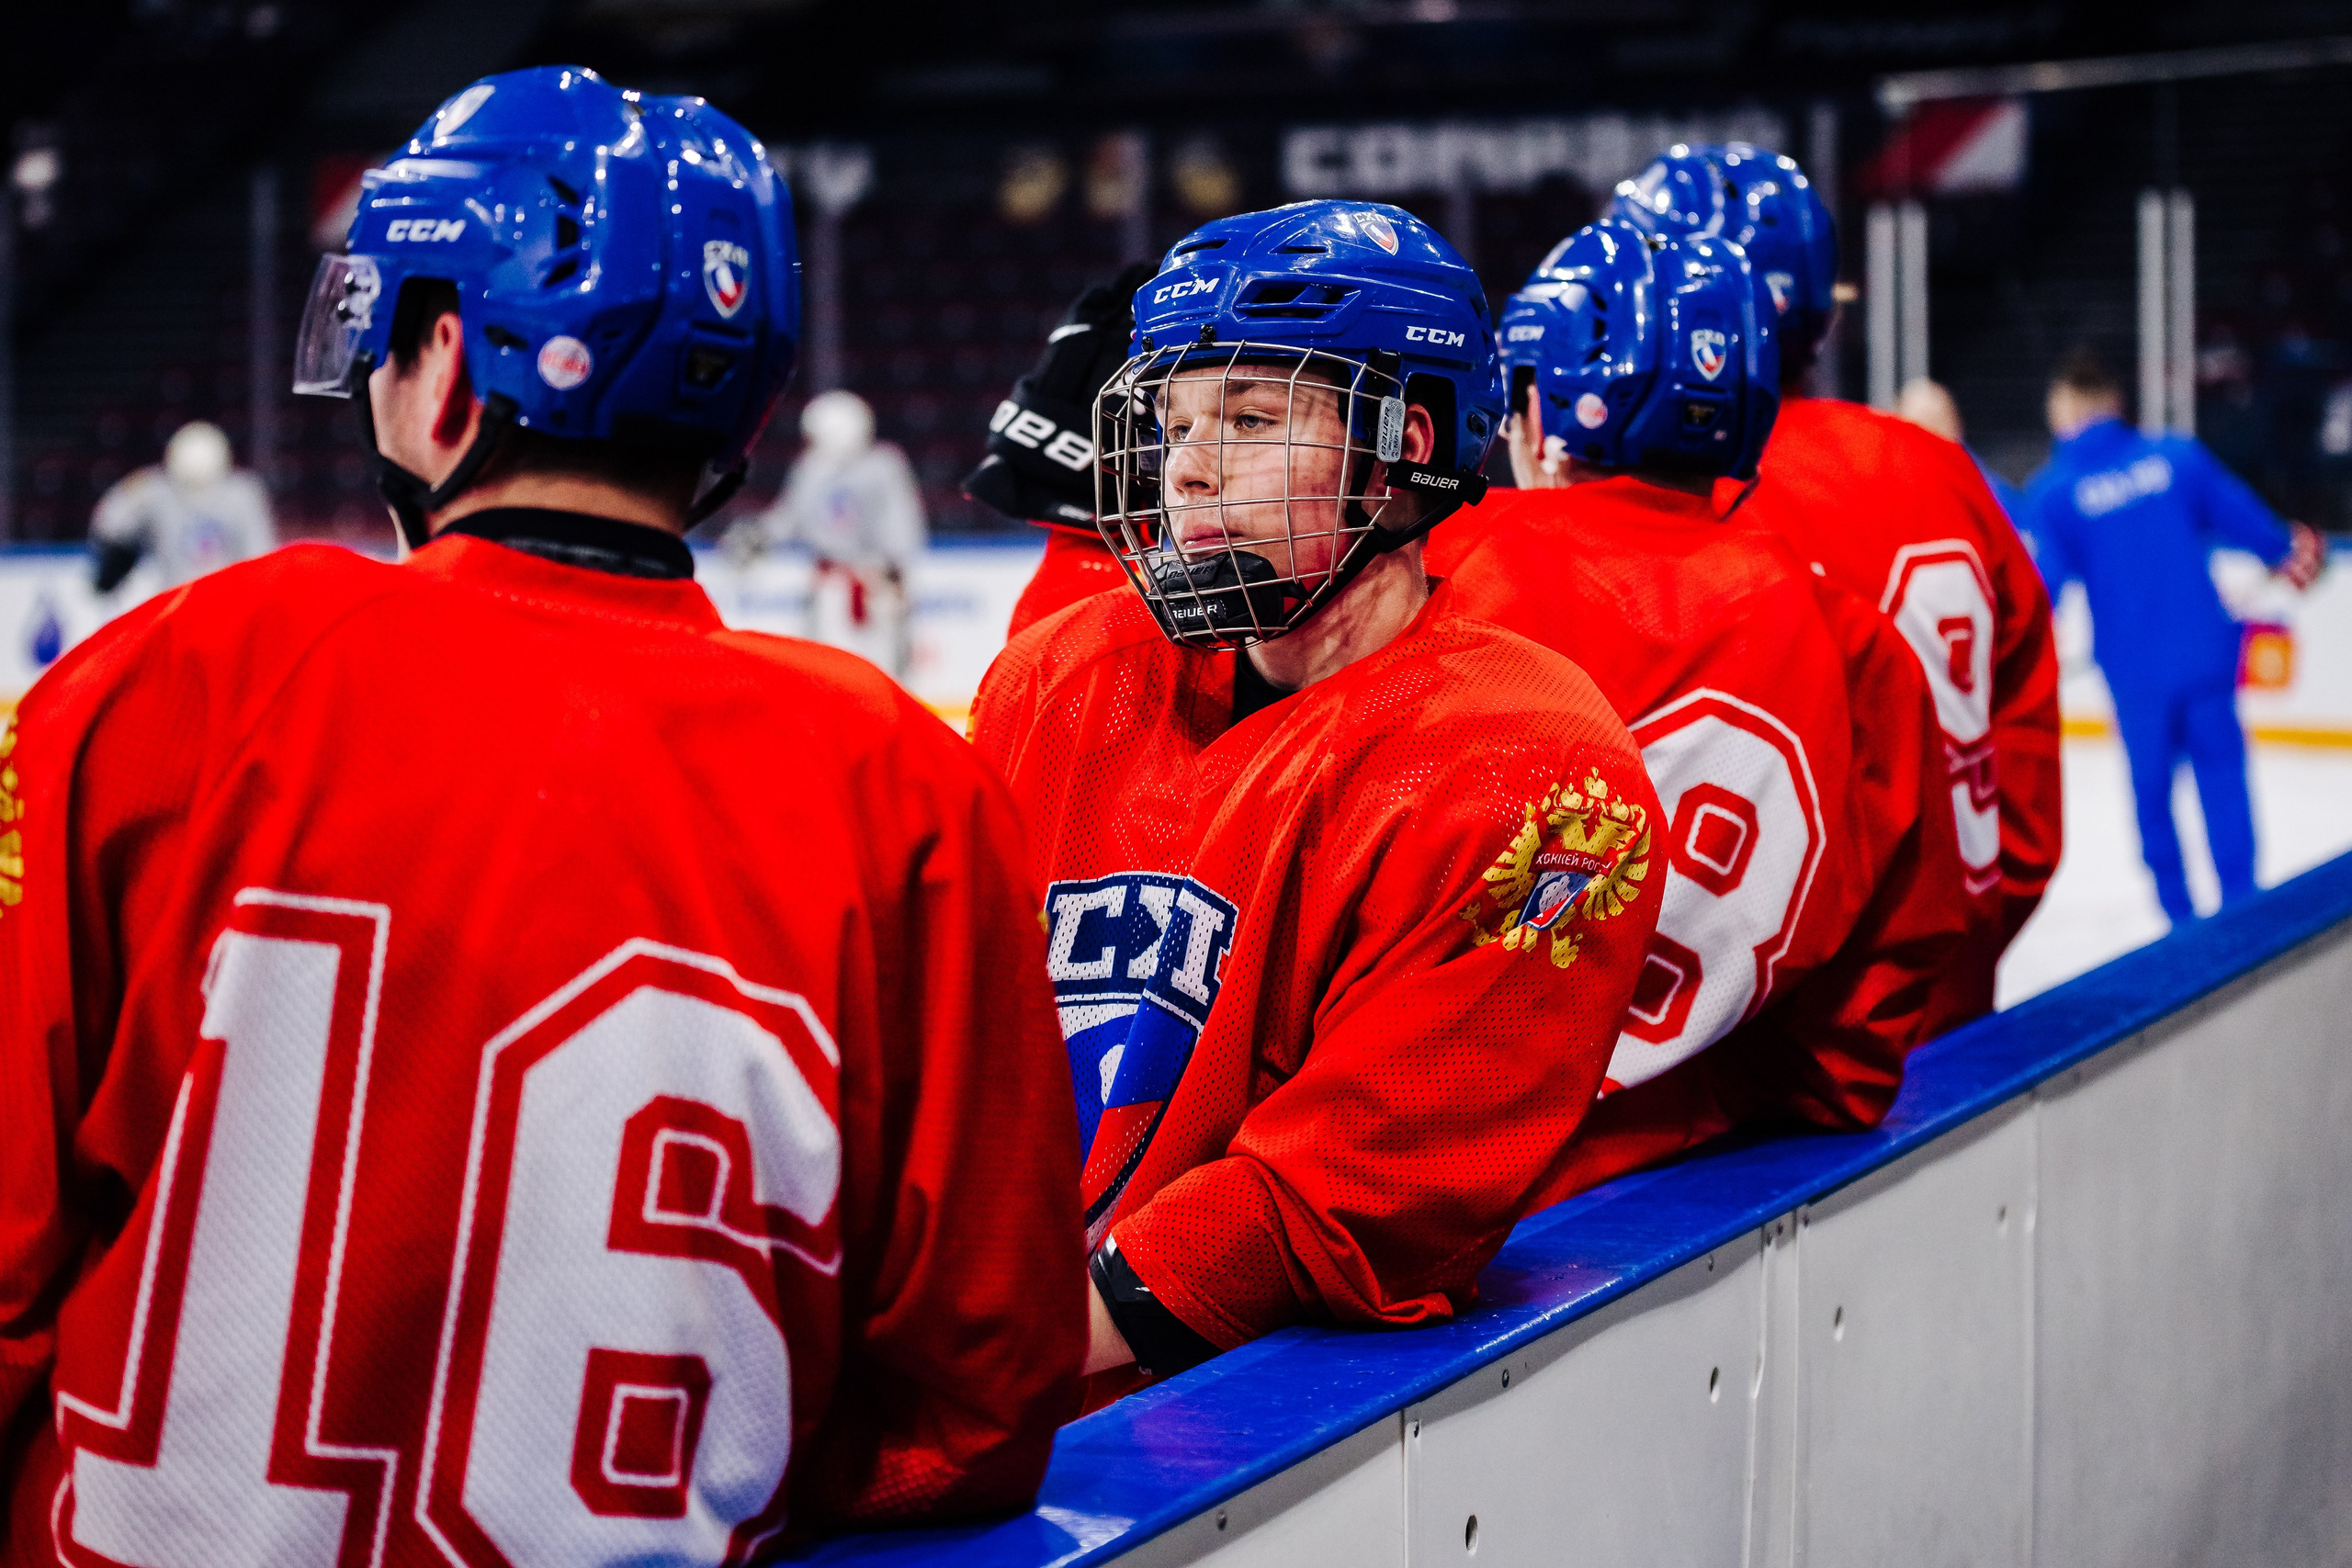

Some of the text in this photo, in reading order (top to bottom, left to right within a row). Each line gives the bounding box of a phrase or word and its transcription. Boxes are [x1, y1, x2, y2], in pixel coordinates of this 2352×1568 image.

[386, 219, 467, 243] CCM
[1154, 277, 1220, 304] CCM
[1405, 325, 1465, 347] CCM
[1410, 472, 1460, 490] BAUER
[1536, 852, 1579, 866] ХОККЕЙ
[1595, 687, 1826, 1100] 8
[20, 886, 843, 1568] 16
